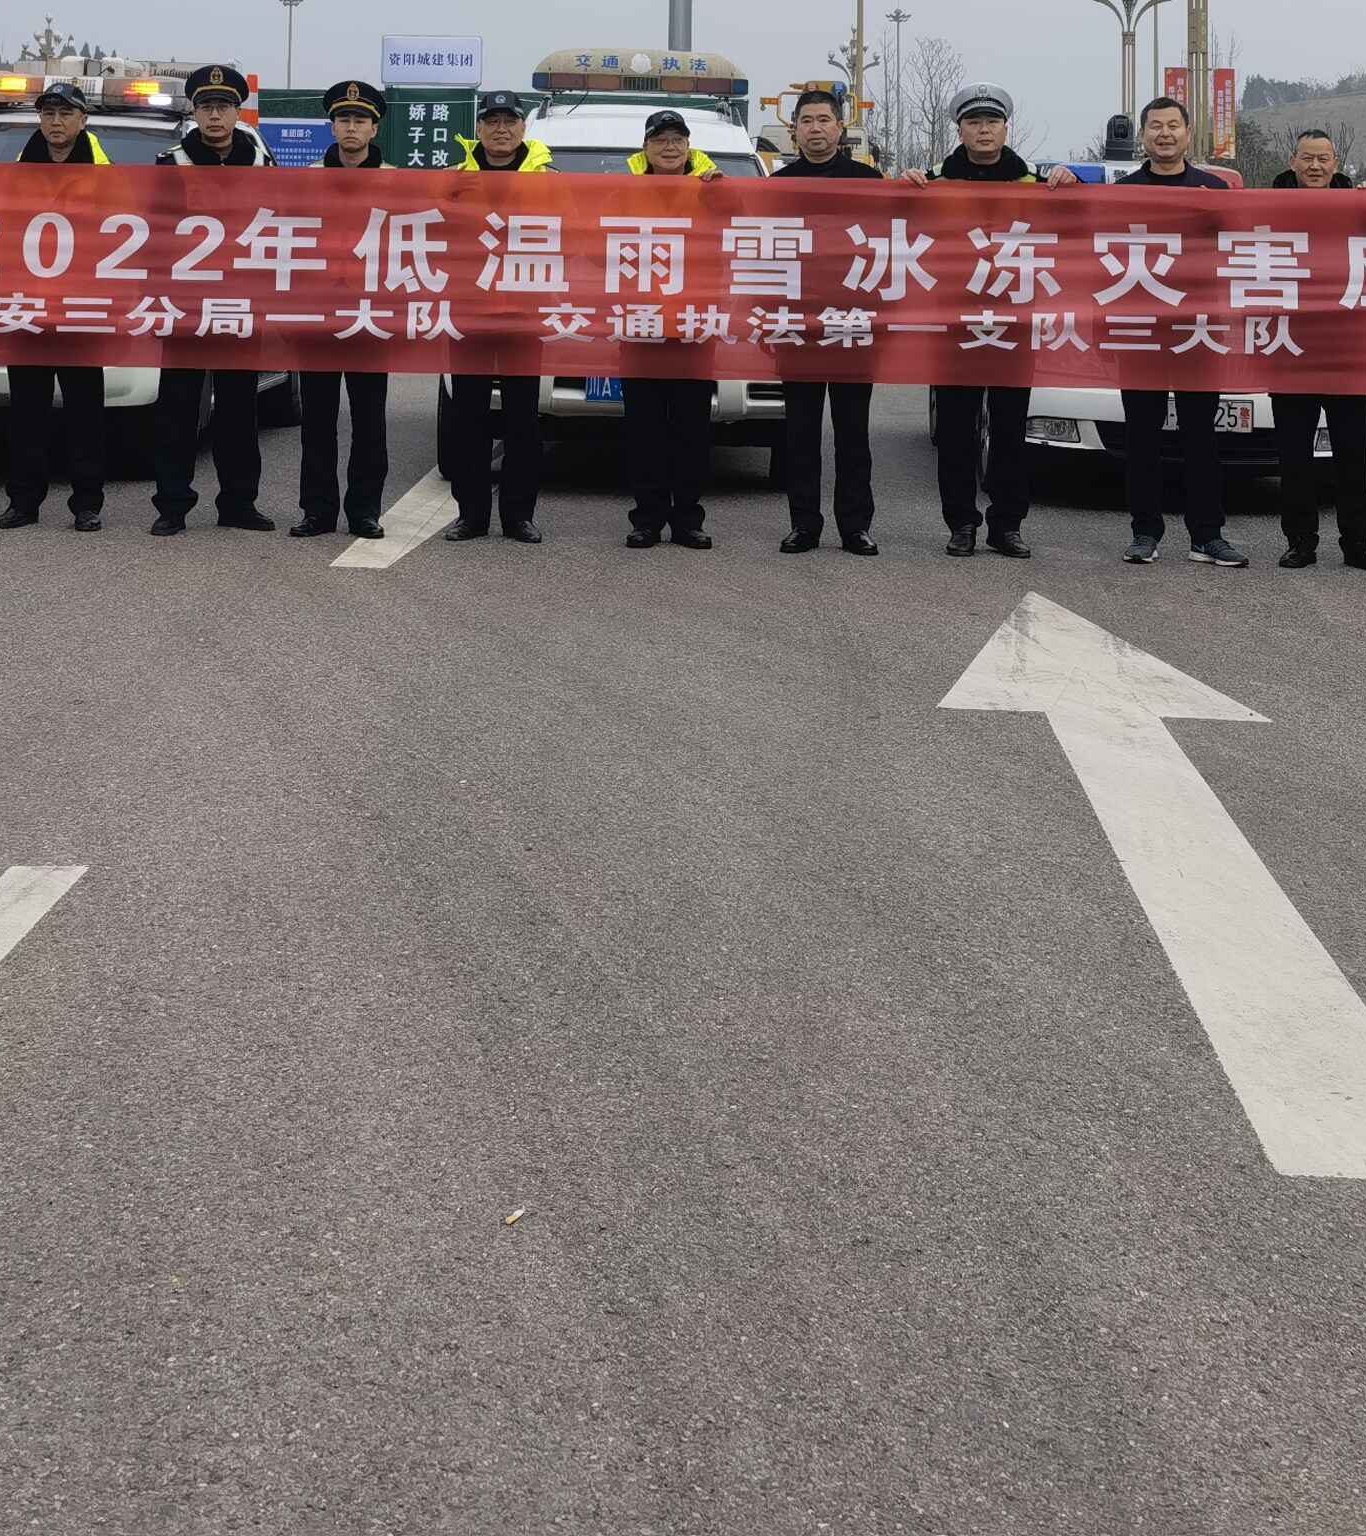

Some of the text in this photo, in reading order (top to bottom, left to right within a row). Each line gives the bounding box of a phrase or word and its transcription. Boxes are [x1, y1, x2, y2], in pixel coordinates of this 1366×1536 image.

[389, 52, 473, 67] 资阳城建集团
[537, 302, 1305, 357] 交通执法第一支队三大队
